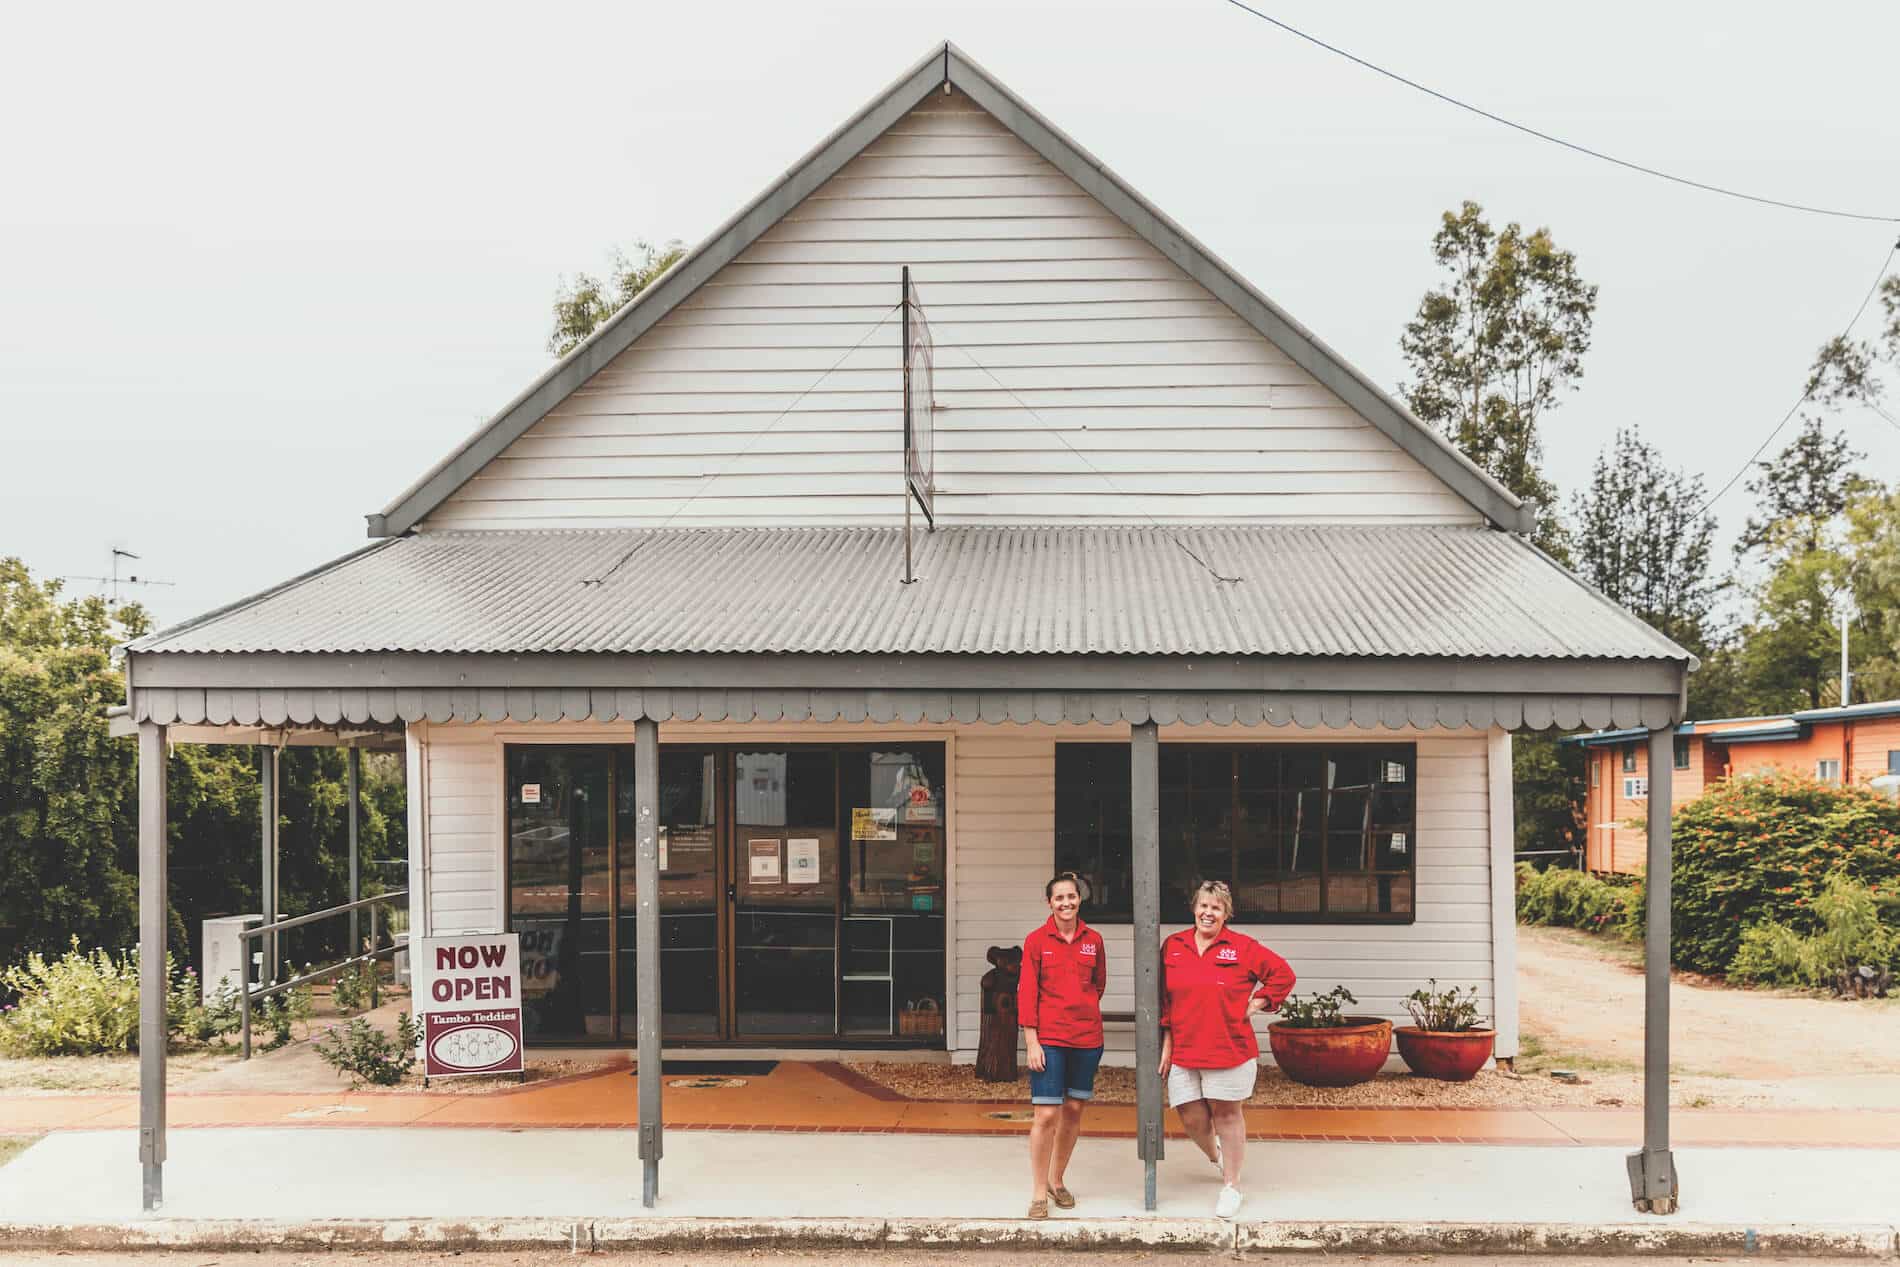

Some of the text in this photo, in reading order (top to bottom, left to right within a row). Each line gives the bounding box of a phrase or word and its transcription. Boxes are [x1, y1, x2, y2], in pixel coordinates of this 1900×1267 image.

[436, 944, 507, 970] NOW
[431, 975, 512, 1002] OPEN
[431, 1010, 517, 1025] Tambo Teddies
